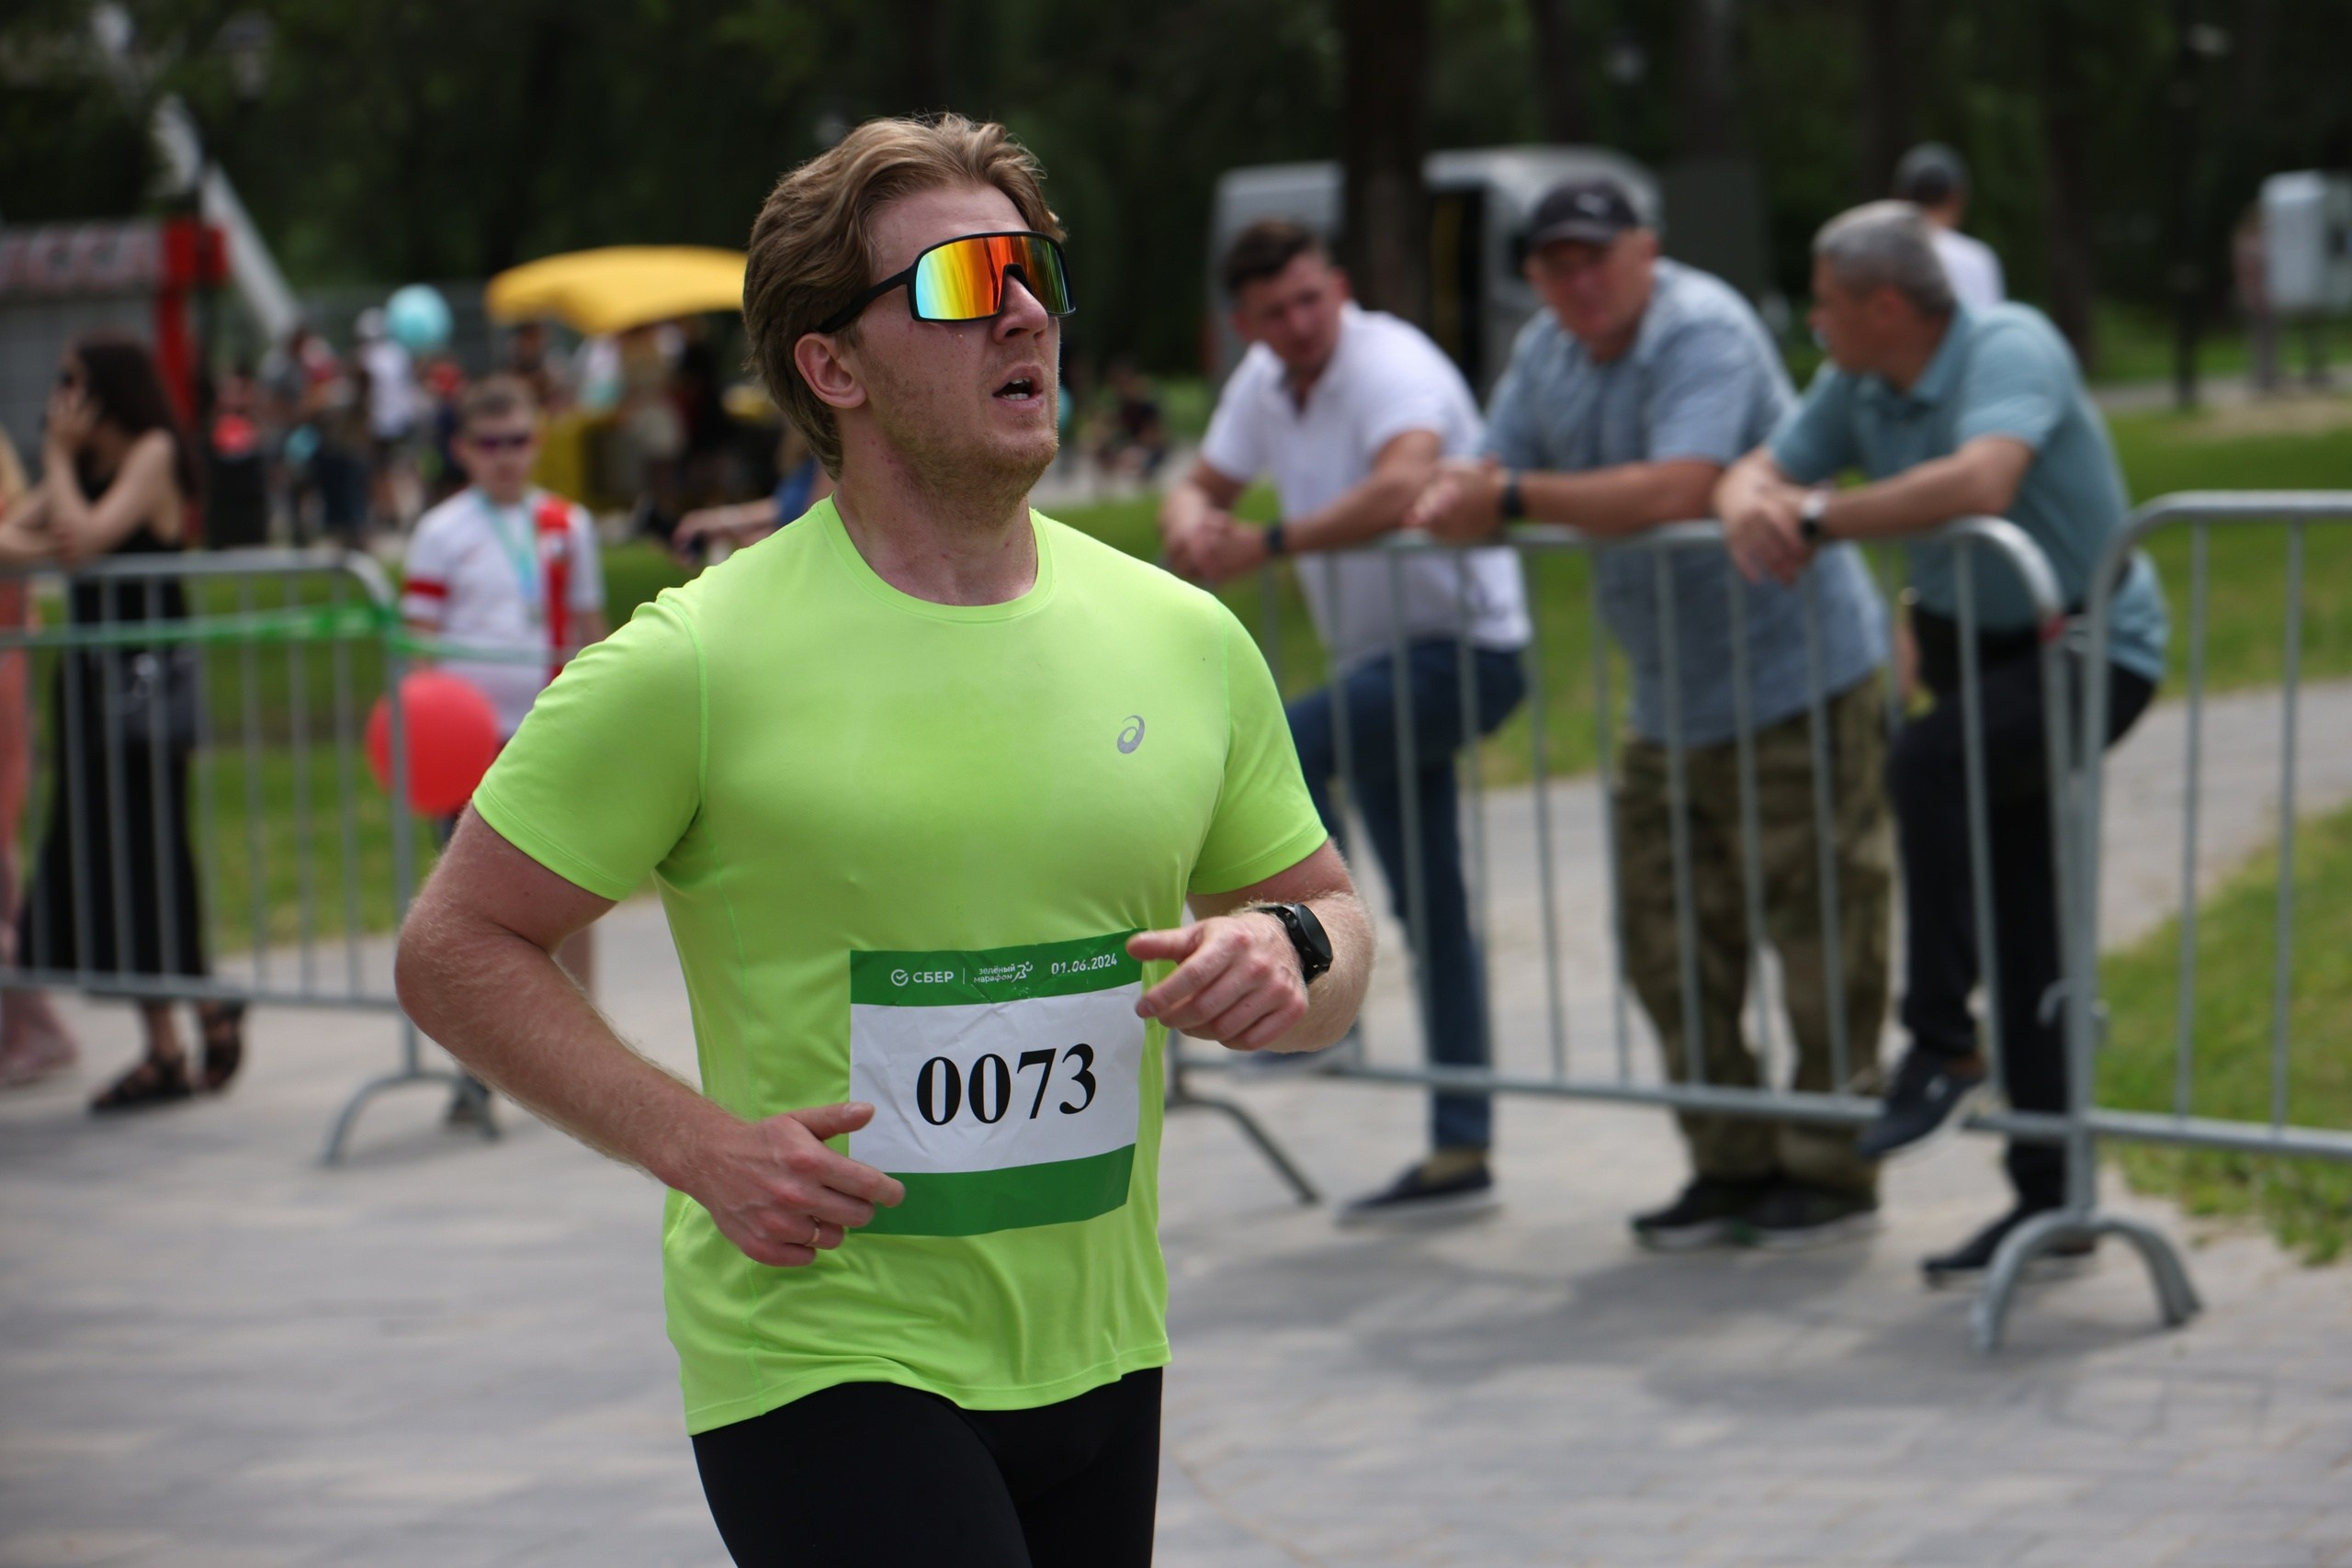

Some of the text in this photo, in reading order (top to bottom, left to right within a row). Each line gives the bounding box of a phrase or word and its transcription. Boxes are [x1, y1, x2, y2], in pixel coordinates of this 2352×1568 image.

[978, 963, 1016, 975] зелёный
[1051, 953, 1117, 975] 01.06.2024
[912, 971, 955, 983] СБЕР
[973, 974, 1012, 984] марафон
[916, 1043, 1096, 1126] 0073
